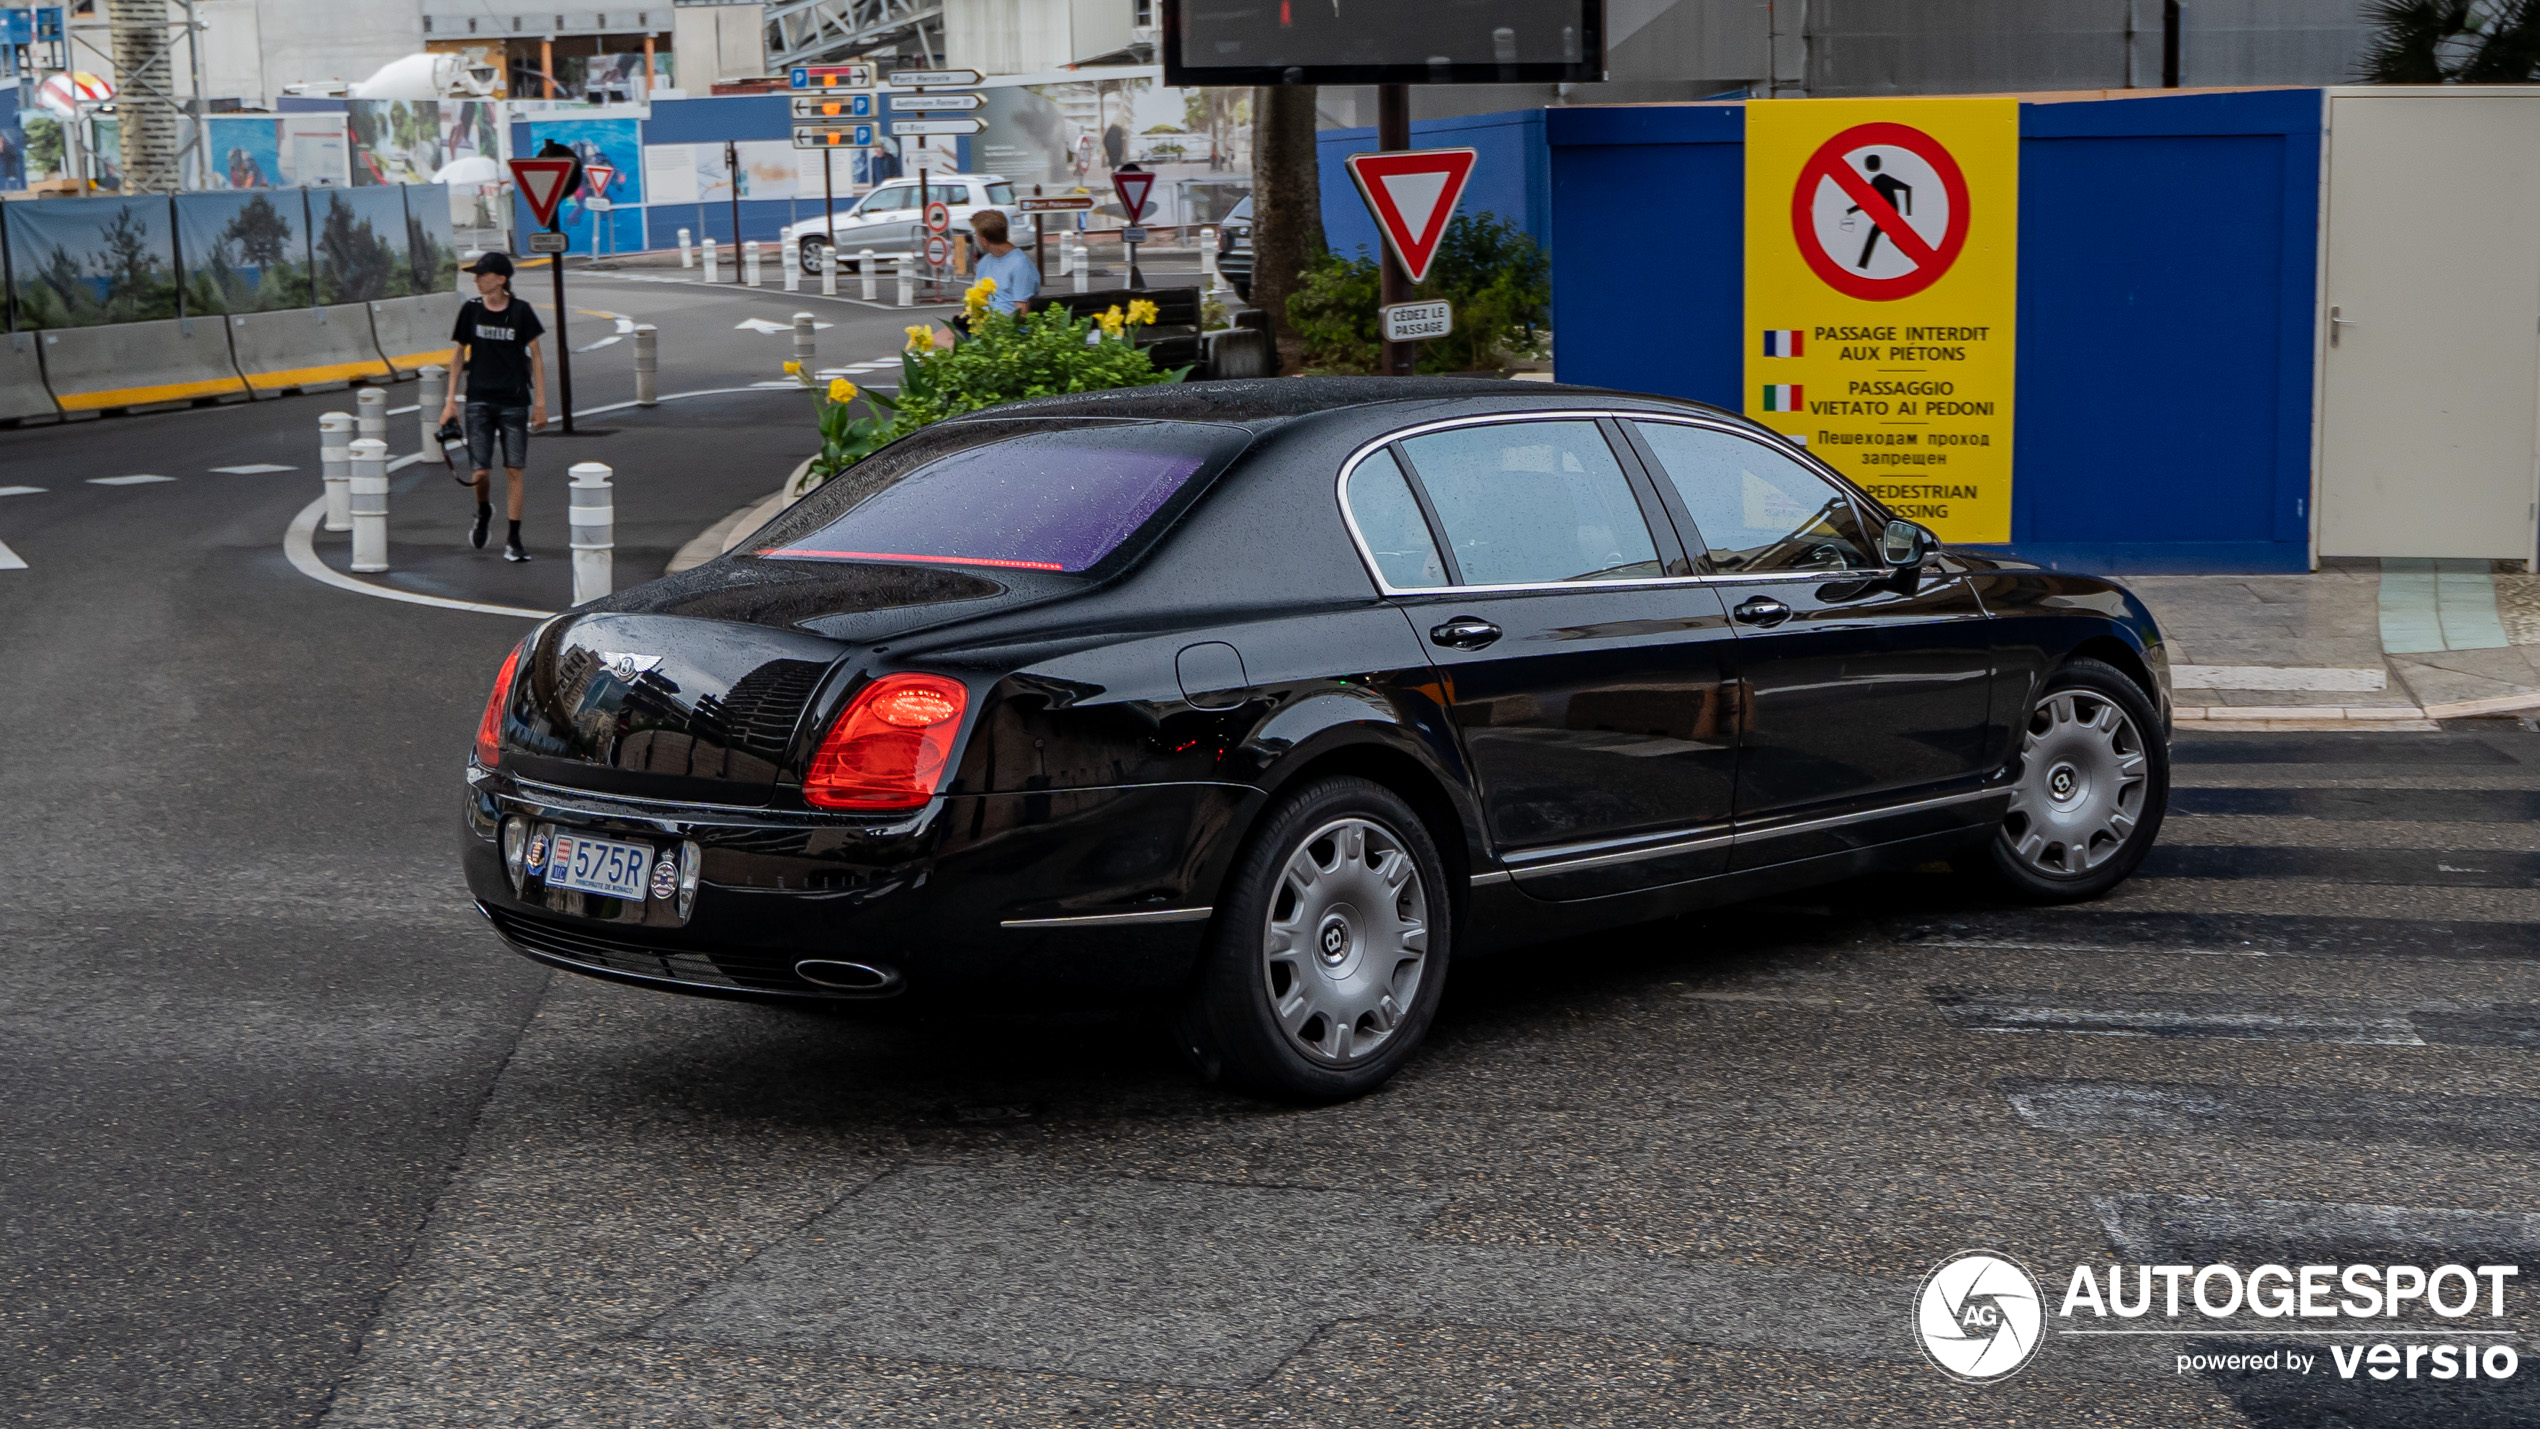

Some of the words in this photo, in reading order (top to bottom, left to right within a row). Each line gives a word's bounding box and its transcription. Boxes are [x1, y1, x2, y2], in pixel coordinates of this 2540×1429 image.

[795, 71, 804, 84] P
[856, 99, 866, 112] P
[859, 128, 868, 142] P
[1394, 308, 1427, 322] CÉDEZ
[1432, 307, 1444, 318] LE
[1396, 321, 1443, 336] PASSAGE
[1815, 326, 1897, 341] PASSAGE
[1905, 326, 1990, 341] INTERDIT
[1839, 346, 1880, 361] AUX
[1889, 342, 1966, 361] PIÉTONS
[1848, 381, 1954, 396] PASSAGGIO
[1810, 401, 1889, 416] VIETATO
[1897, 401, 1917, 415] AI
[1926, 401, 1995, 416] PEDONI
[1818, 430, 1918, 446] Пешеходам
[1928, 433, 1990, 447] проход
[1861, 453, 1947, 466] запрещен
[1866, 485, 1978, 499] PEDESTRIAN
[1885, 503, 1949, 519] OSSING
[575, 841, 643, 887] 575R
[554, 866, 565, 879] MC
[612, 884, 634, 895] MONACO
